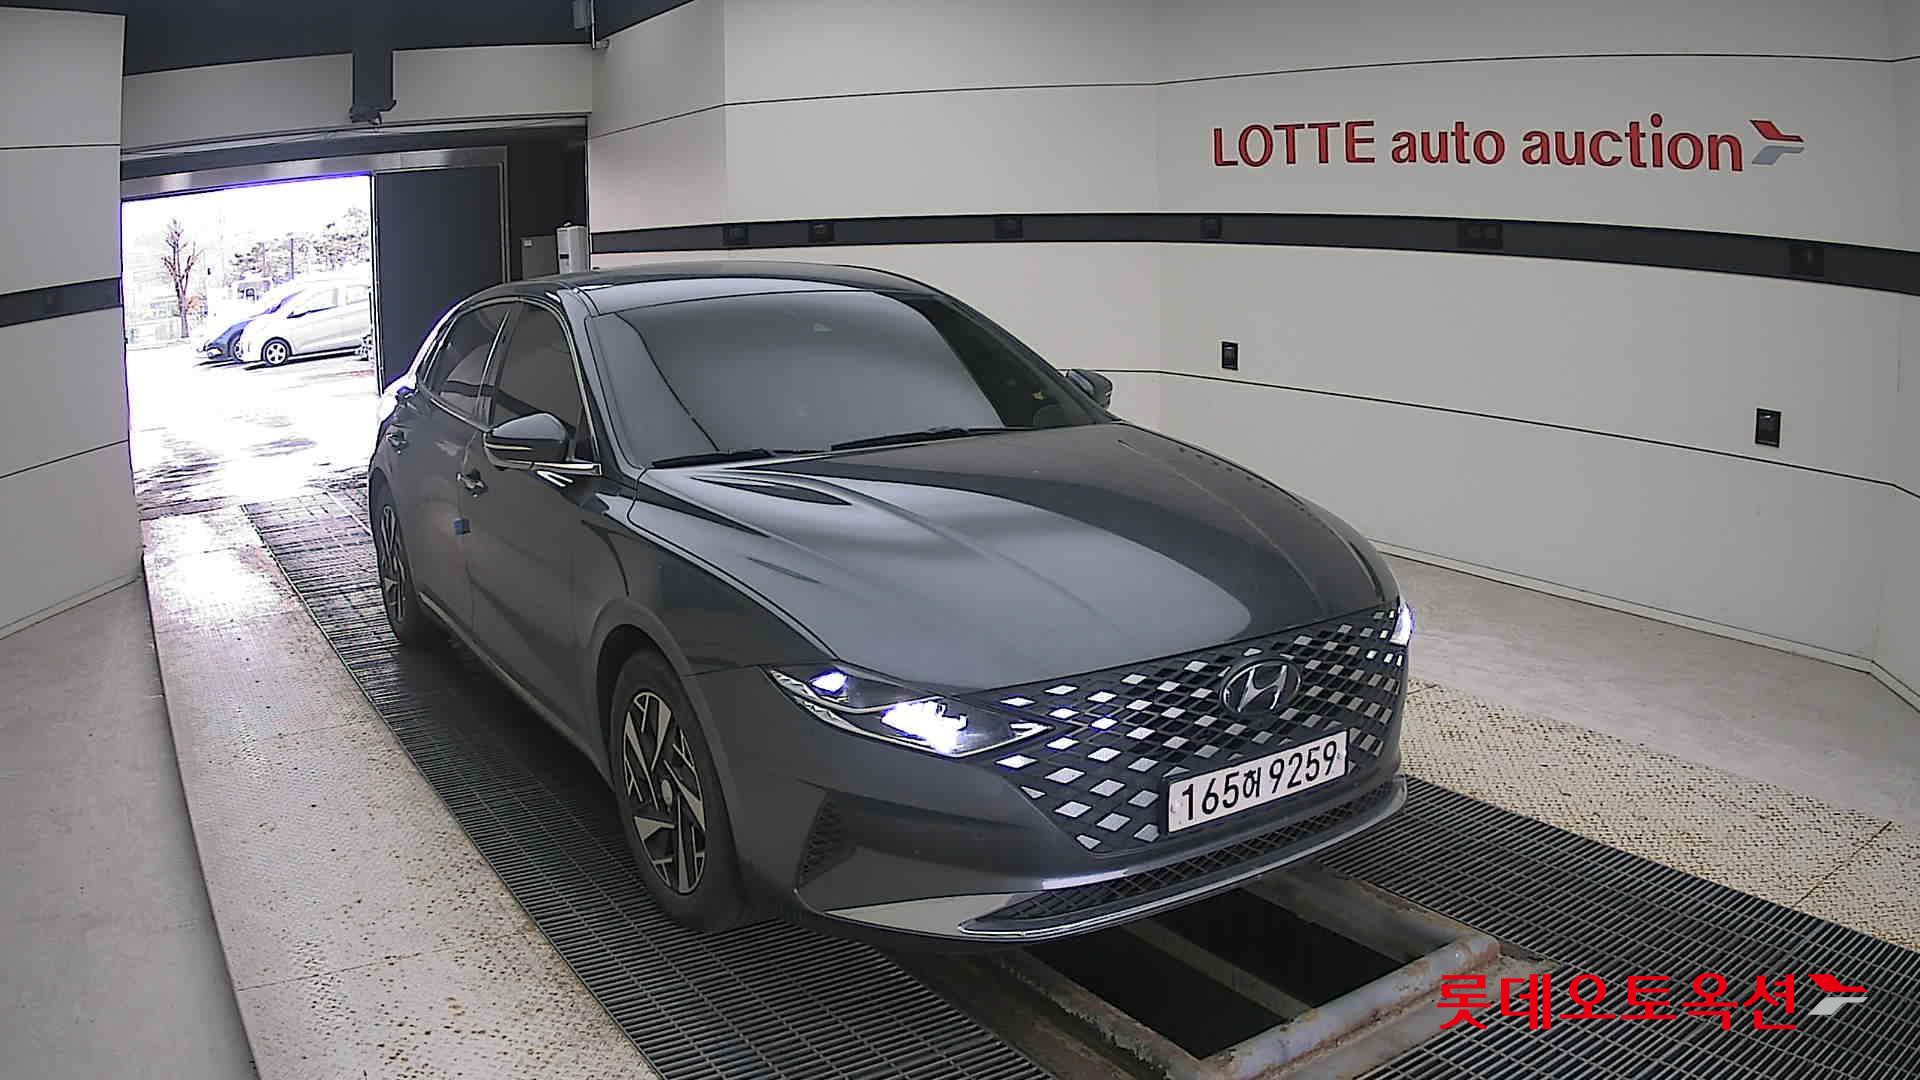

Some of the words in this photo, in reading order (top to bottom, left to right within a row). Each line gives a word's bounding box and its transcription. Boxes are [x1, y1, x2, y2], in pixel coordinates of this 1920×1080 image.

[1213, 121, 1377, 168] LOTTE
[1392, 121, 1508, 165] auto
[1521, 114, 1744, 173] auction
[1181, 766, 1262, 821] 165허
[1269, 740, 1338, 795] 9259
